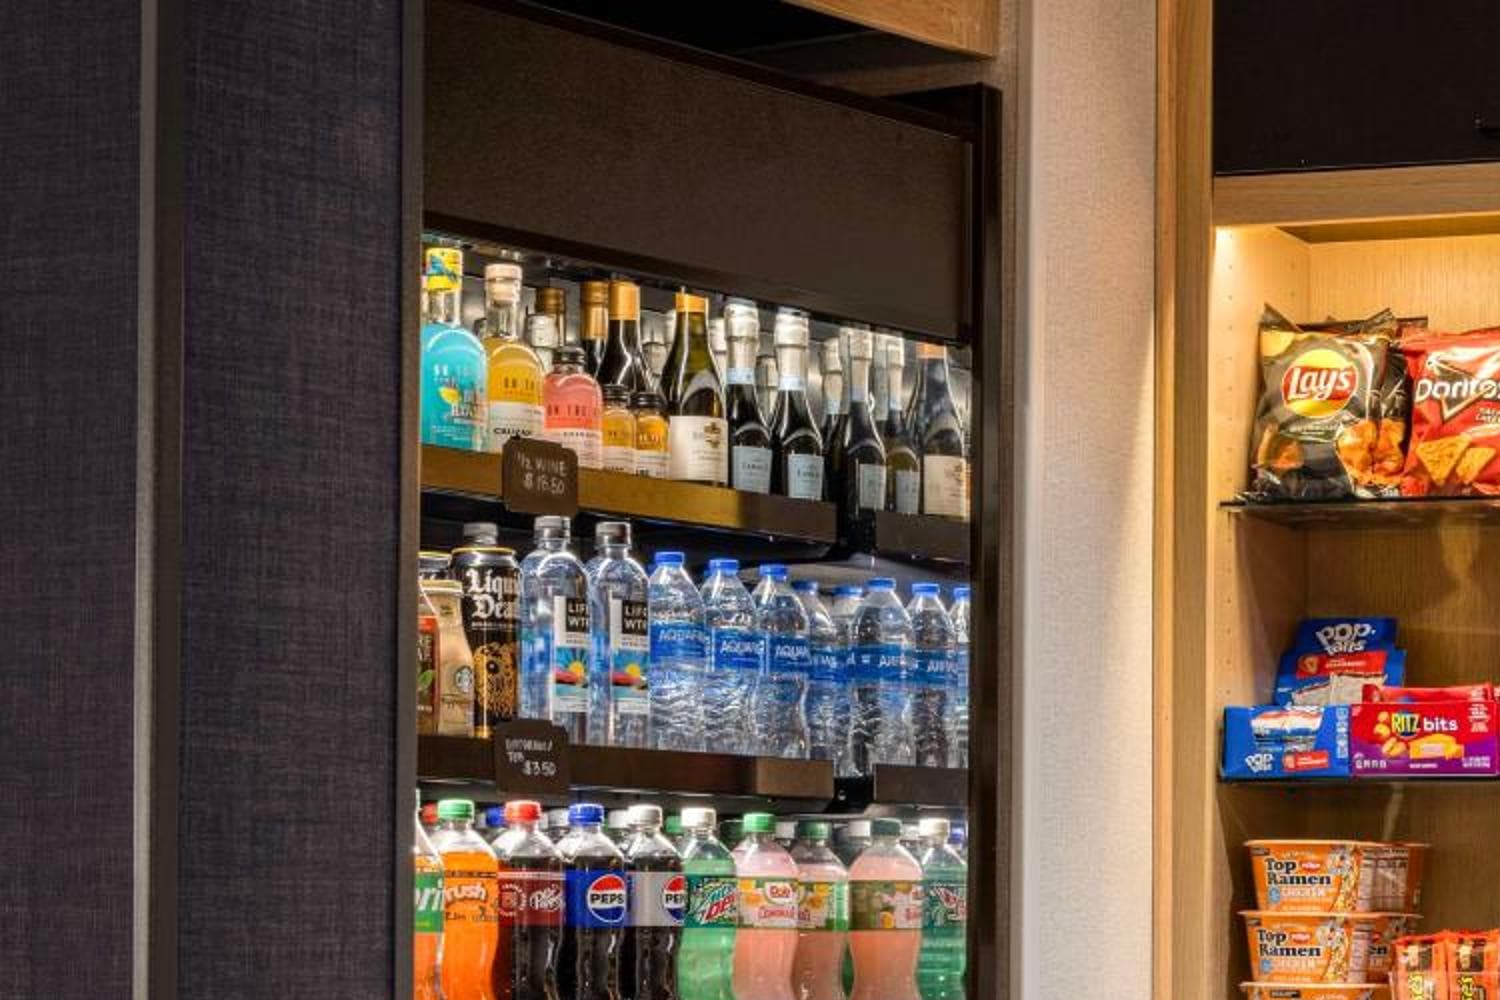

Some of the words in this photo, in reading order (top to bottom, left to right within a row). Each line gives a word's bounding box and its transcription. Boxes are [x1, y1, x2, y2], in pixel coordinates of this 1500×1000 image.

[1390, 713, 1421, 732] RITZ
[1423, 716, 1459, 732] bits
[1265, 857, 1297, 875] Top
[1266, 872, 1332, 886] Ramen
[445, 882, 487, 901] rush
[590, 892, 625, 904] PEPS
[665, 893, 687, 904] PEP
[1257, 929, 1287, 946] Top
[1259, 944, 1321, 957] Ramen
